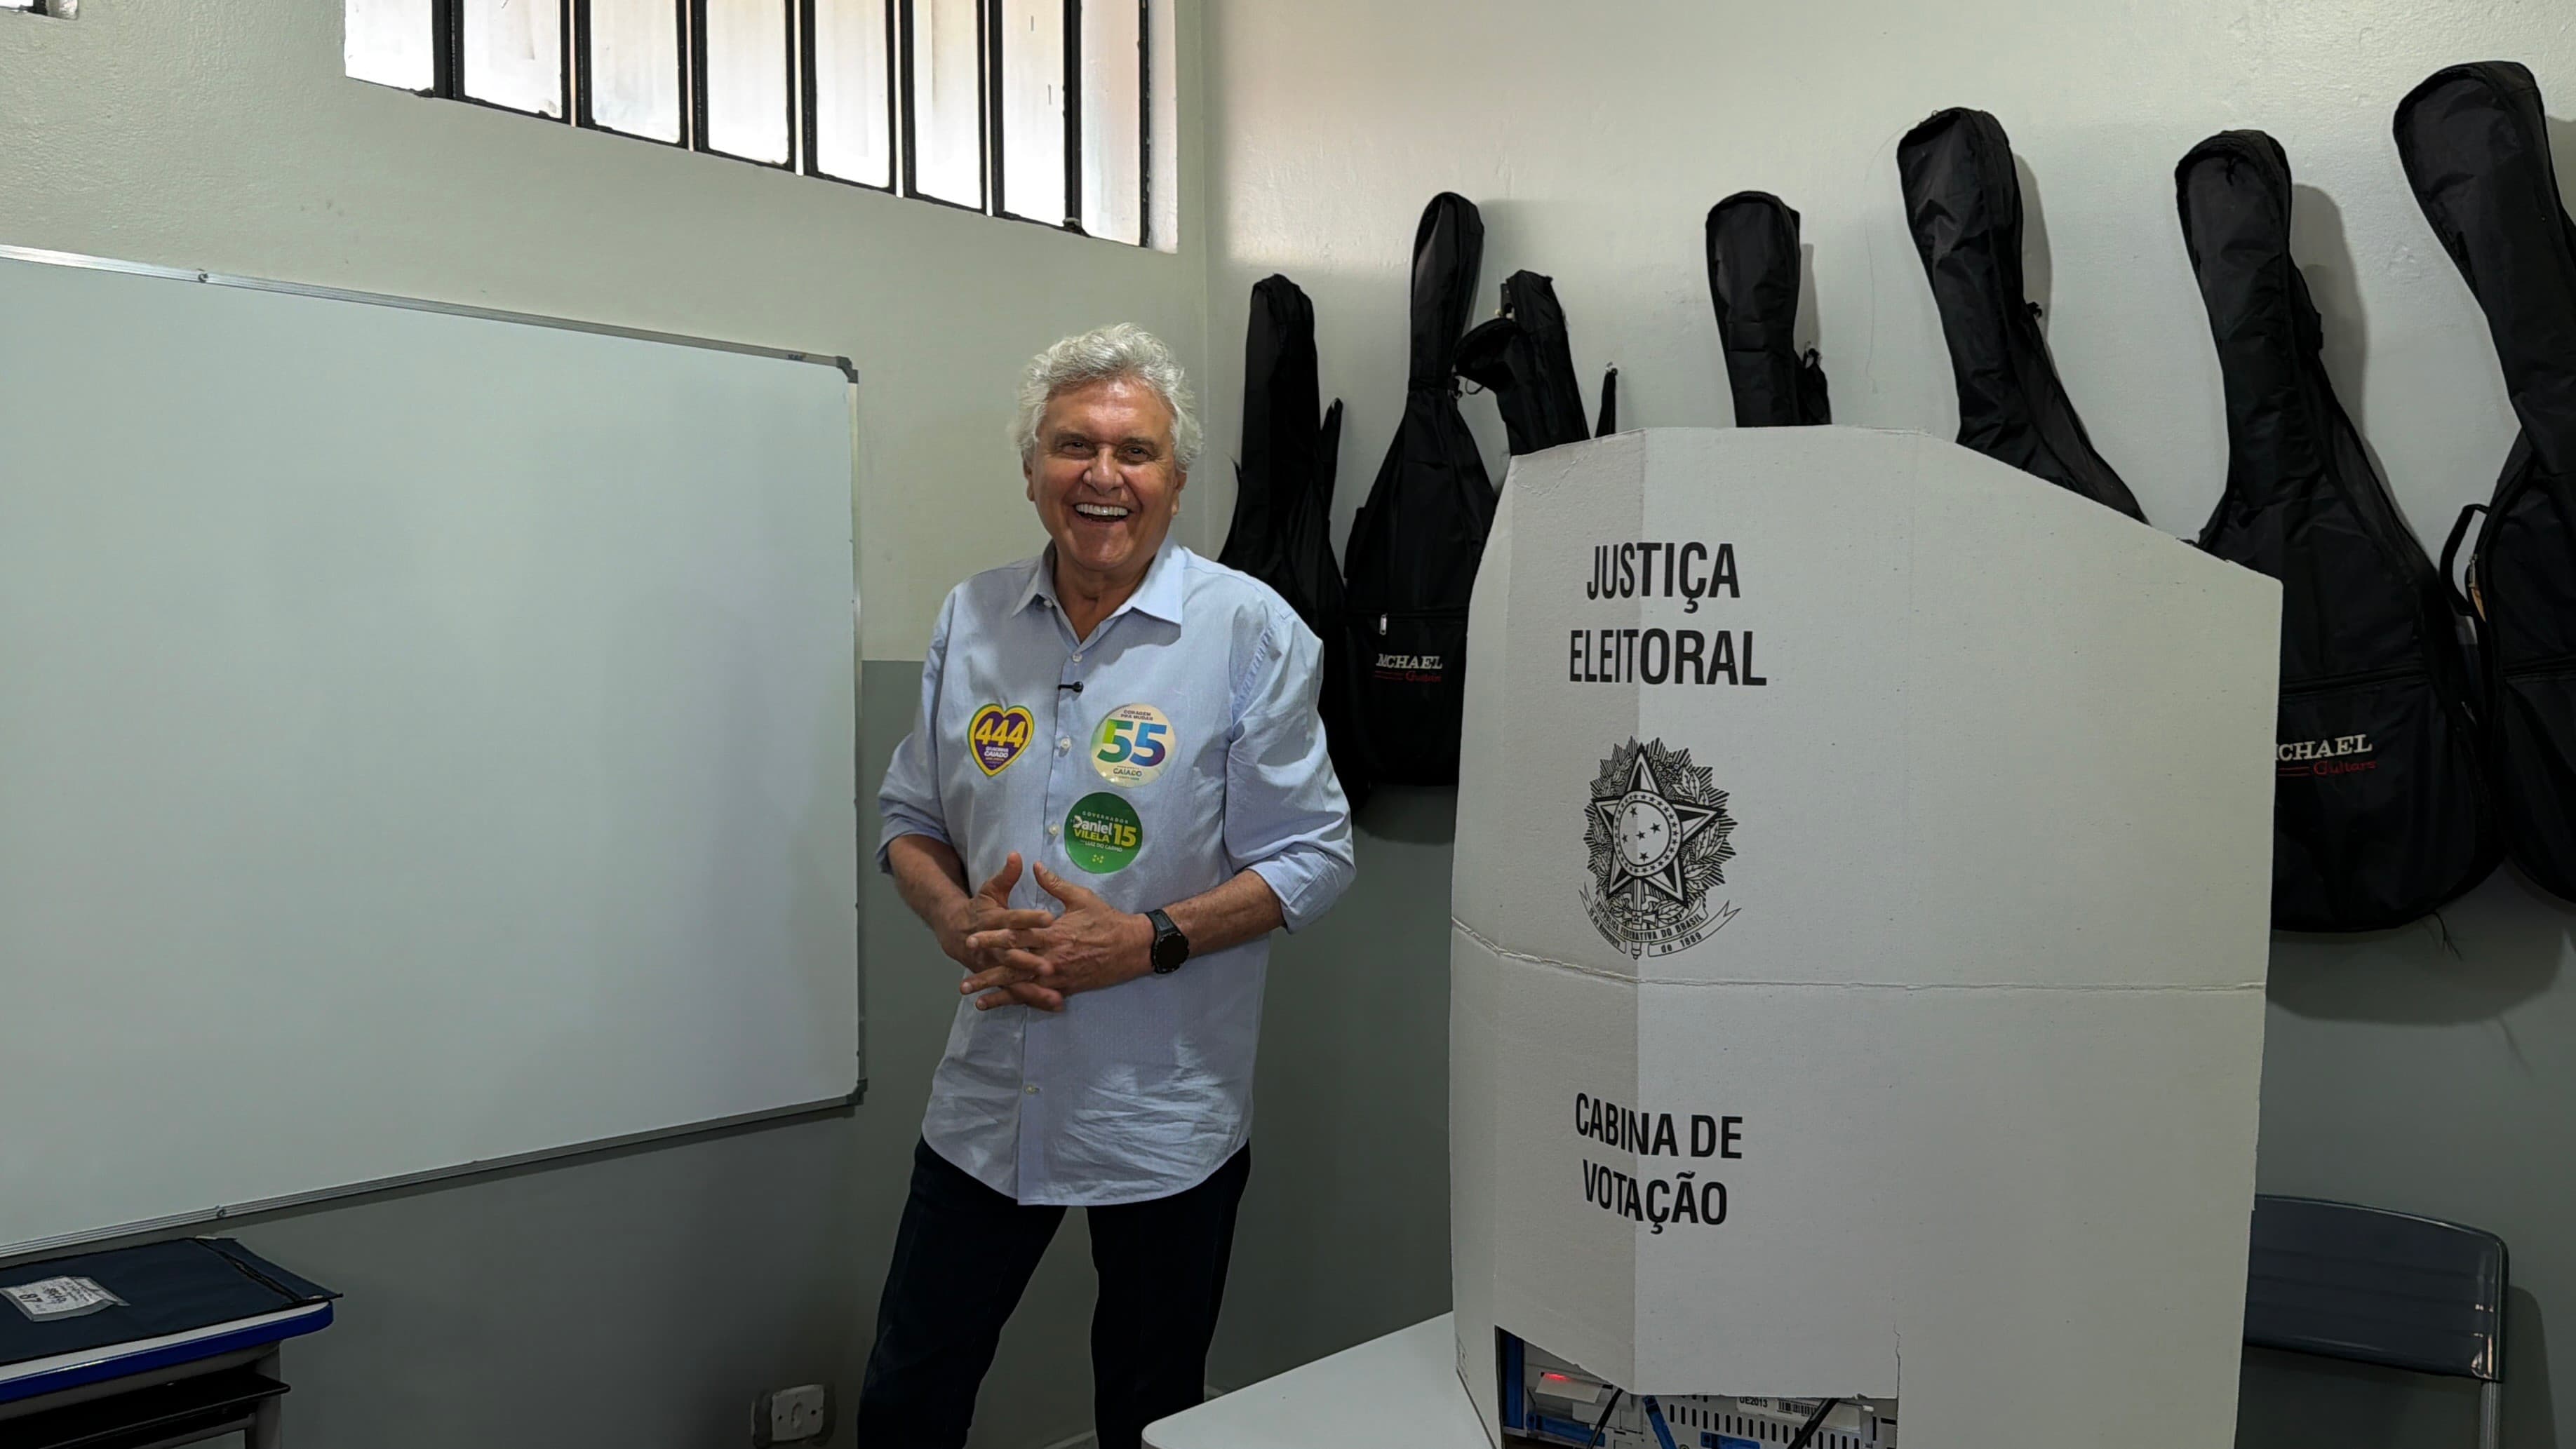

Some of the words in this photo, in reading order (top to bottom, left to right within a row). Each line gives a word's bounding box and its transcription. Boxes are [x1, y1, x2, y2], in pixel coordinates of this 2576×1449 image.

[1587, 541, 1740, 614] JUSTIÇA
[1375, 653, 1443, 670] MCHAEL
[1569, 628, 1766, 685] ELEITORAL
[975, 718, 1026, 748] 444
[1096, 719, 1167, 767] 55
[2276, 734, 2373, 762] CHAEL
[1113, 768, 1142, 777] CAIADO
[1073, 815, 1113, 835] Daniel
[1082, 811, 1129, 824] GOVERNADOR
[1074, 828, 1110, 843] VILELA
[1113, 823, 1136, 847] 15
[1661, 928, 1673, 938] DO
[1675, 914, 1703, 931] BRASIL
[1661, 944, 1672, 953] de
[1679, 932, 1702, 948] 1889
[1576, 1093, 1679, 1157] CABINA
[1691, 1114, 1743, 1159] DE
[1583, 1159, 1727, 1234] VOTAÇÃO
